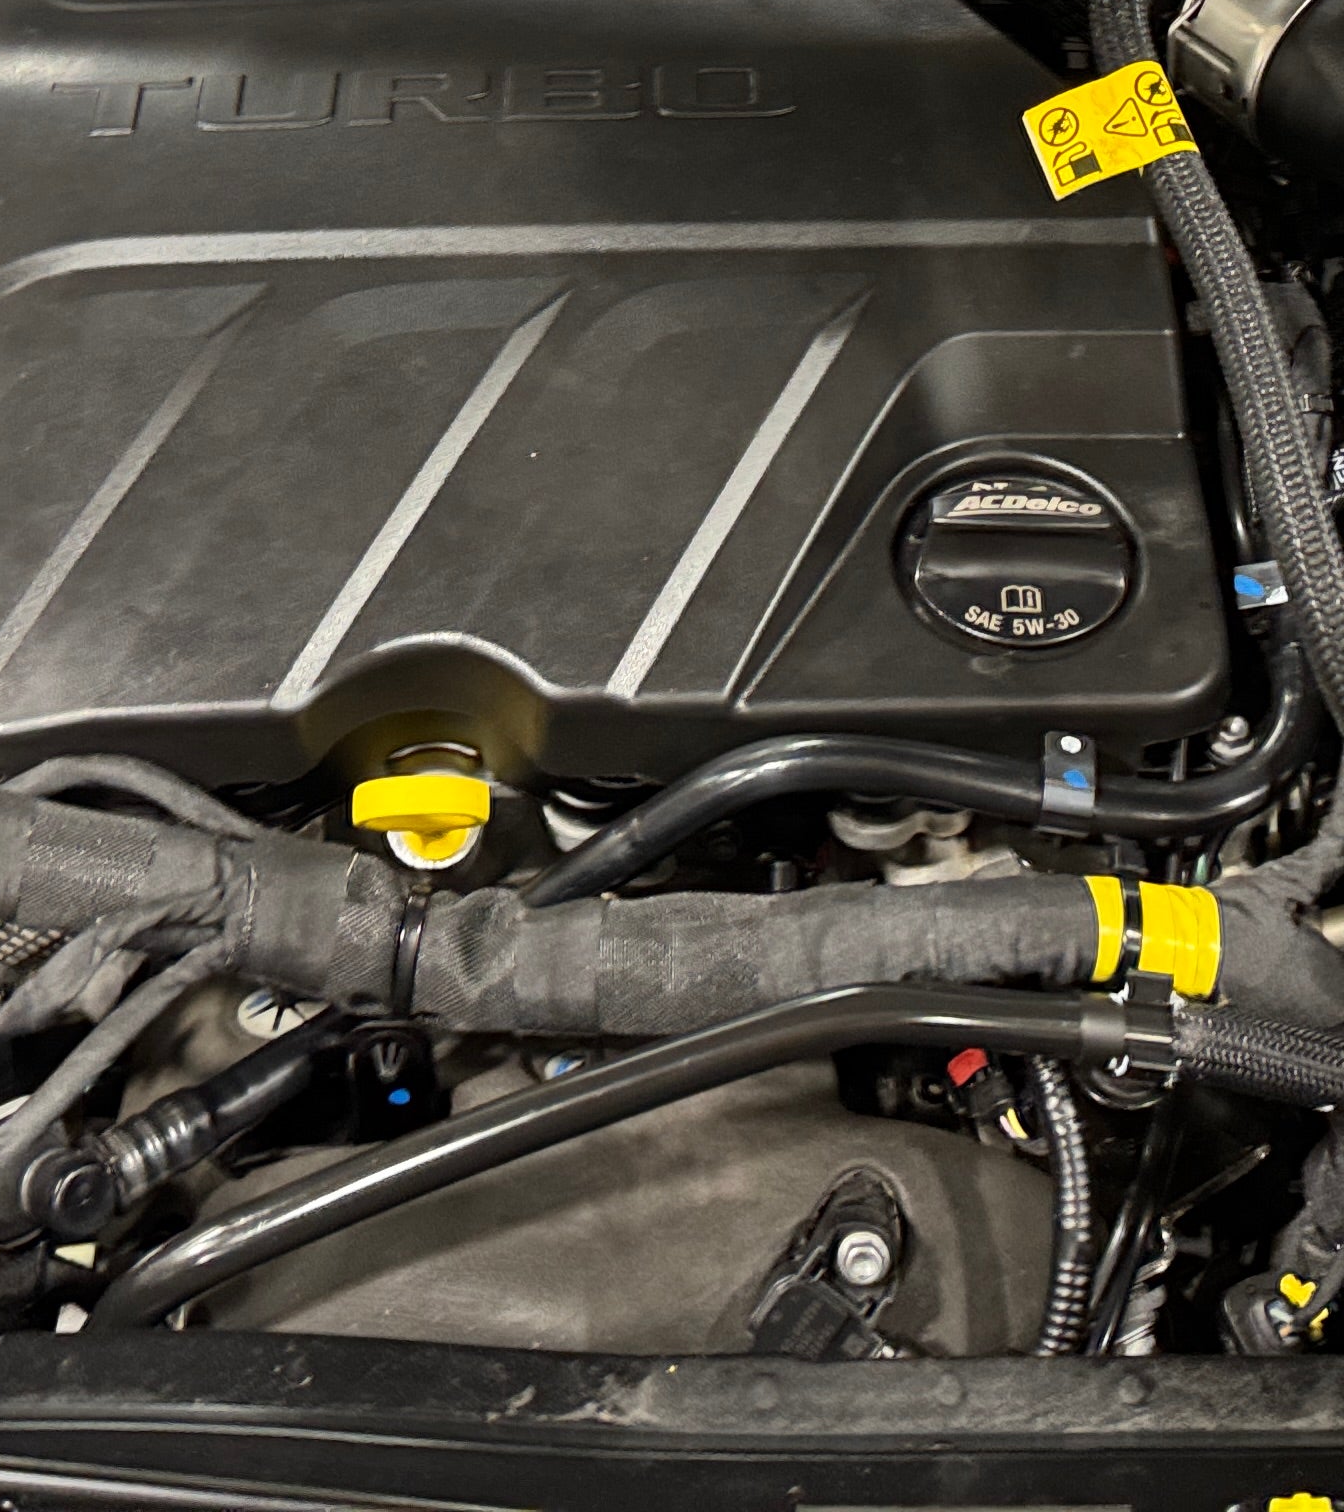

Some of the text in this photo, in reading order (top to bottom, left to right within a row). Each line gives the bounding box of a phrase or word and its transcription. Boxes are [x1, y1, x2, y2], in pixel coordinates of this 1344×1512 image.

[53, 65, 798, 137] TURBO
[952, 495, 1103, 517] ACDelco
[964, 605, 1080, 636] SAE 5W-30
